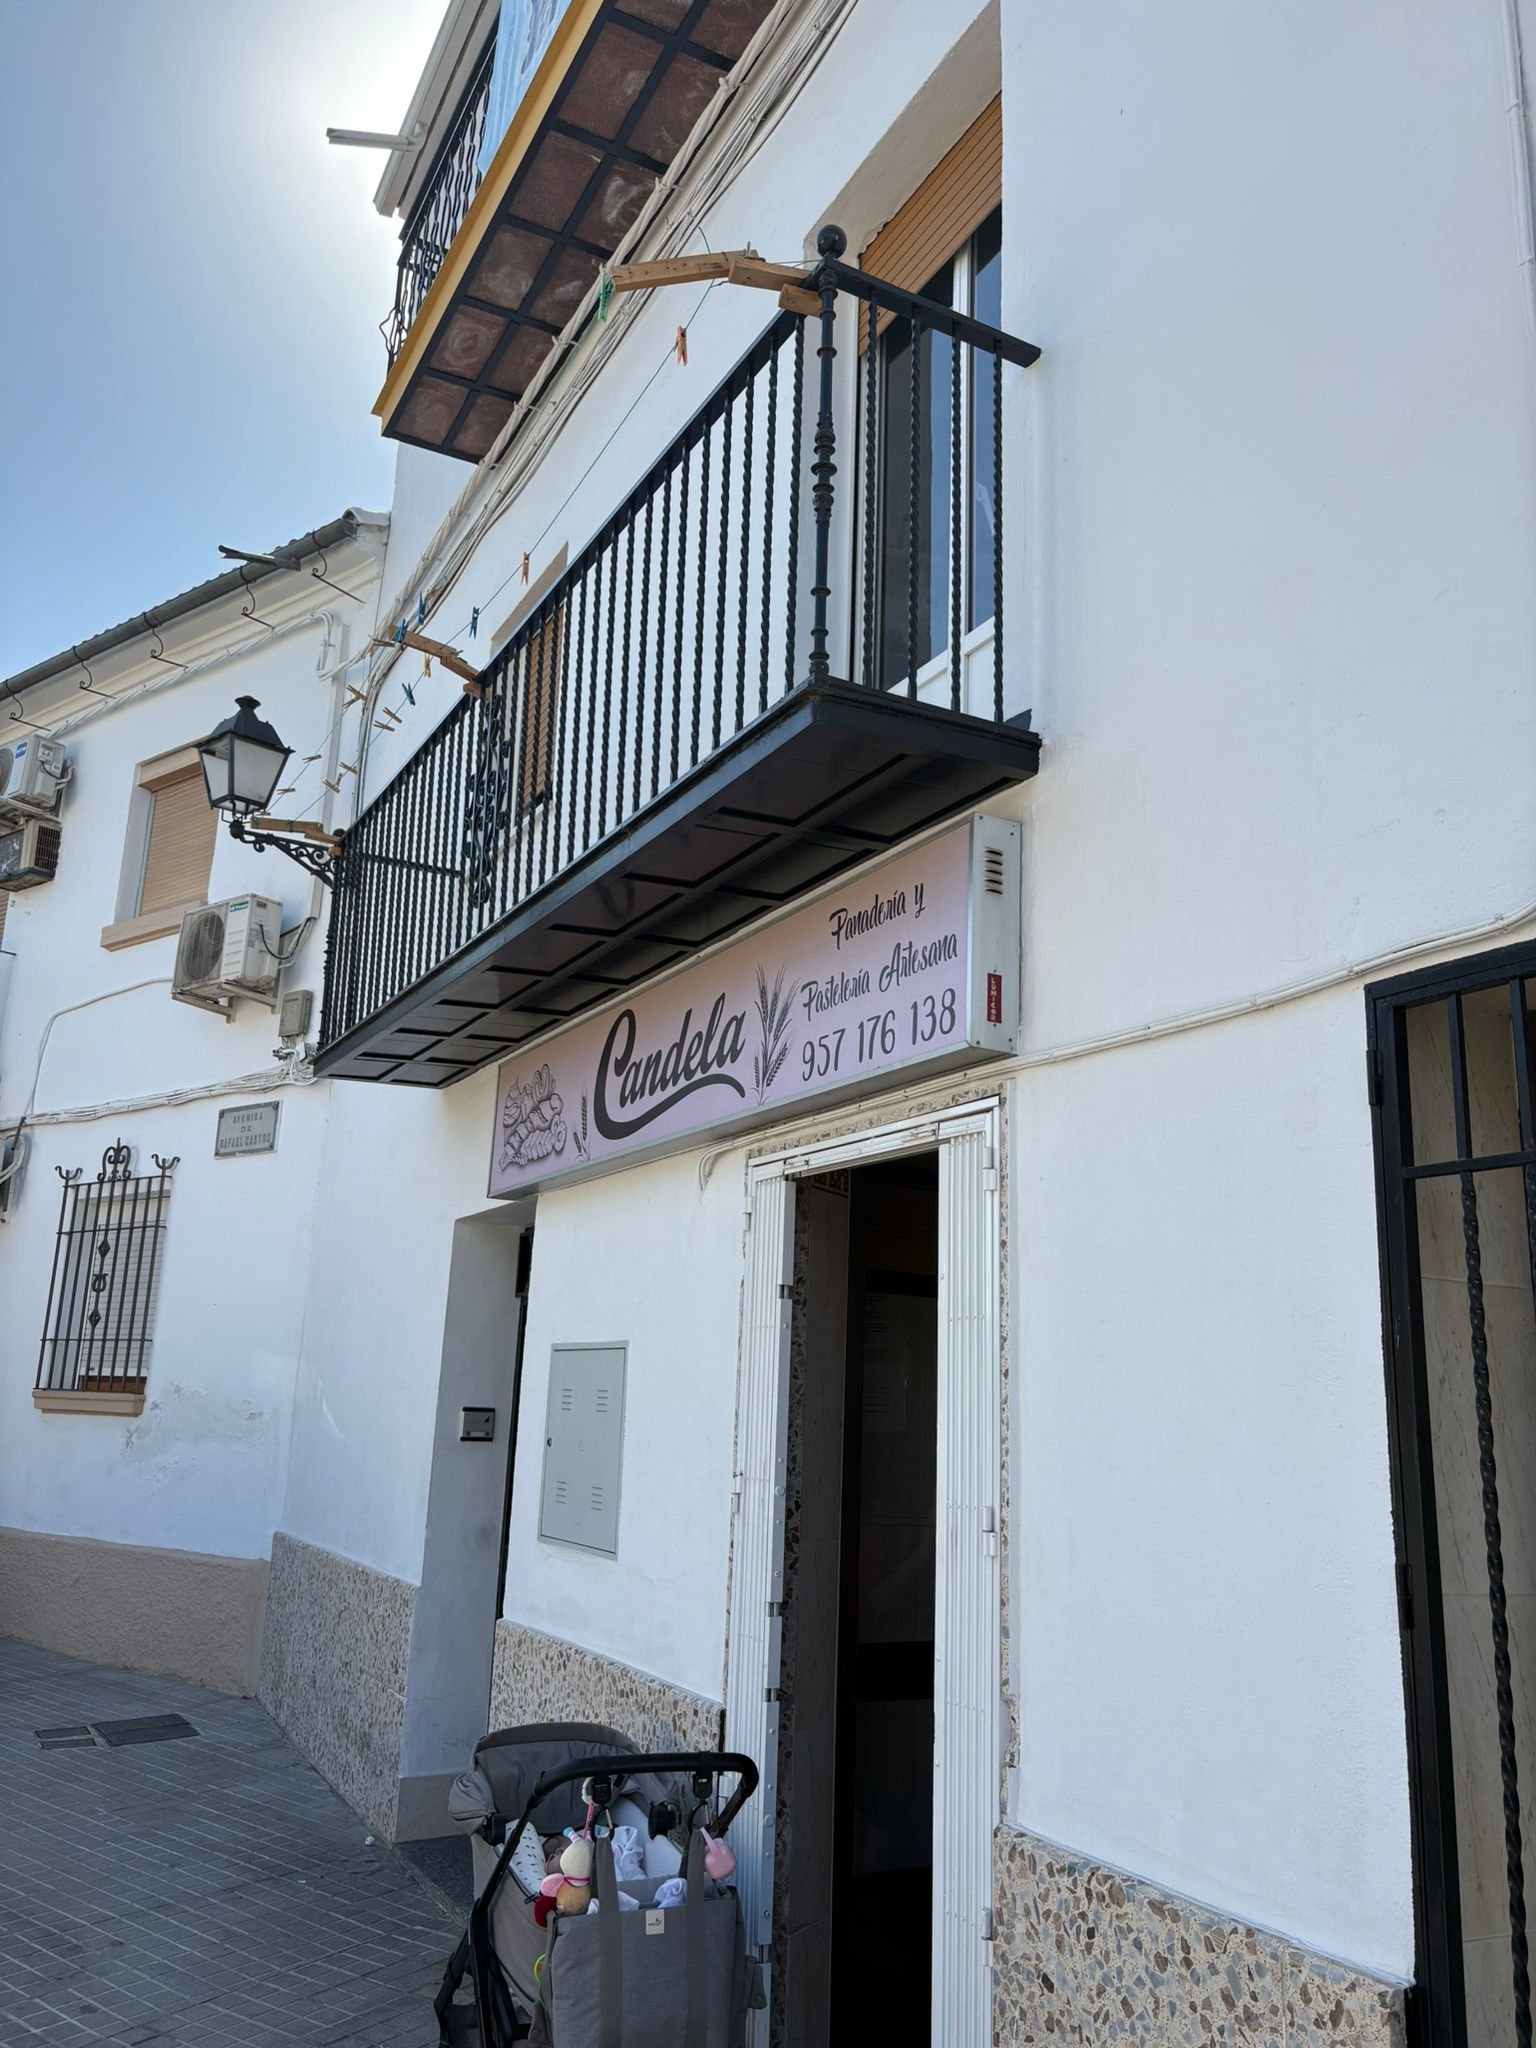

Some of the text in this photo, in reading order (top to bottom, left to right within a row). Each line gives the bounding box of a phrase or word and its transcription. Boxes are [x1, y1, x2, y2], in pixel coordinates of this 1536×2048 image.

[829, 883, 925, 950] Panadería y
[801, 933, 958, 1022] Pastelería Artesana
[594, 992, 746, 1140] Candela
[802, 988, 956, 1082] 957 176 138
[220, 1133, 271, 1149] RAFAEL CASTRO
[233, 1112, 263, 1124] AVENIDA
[241, 1125, 252, 1133] DE
